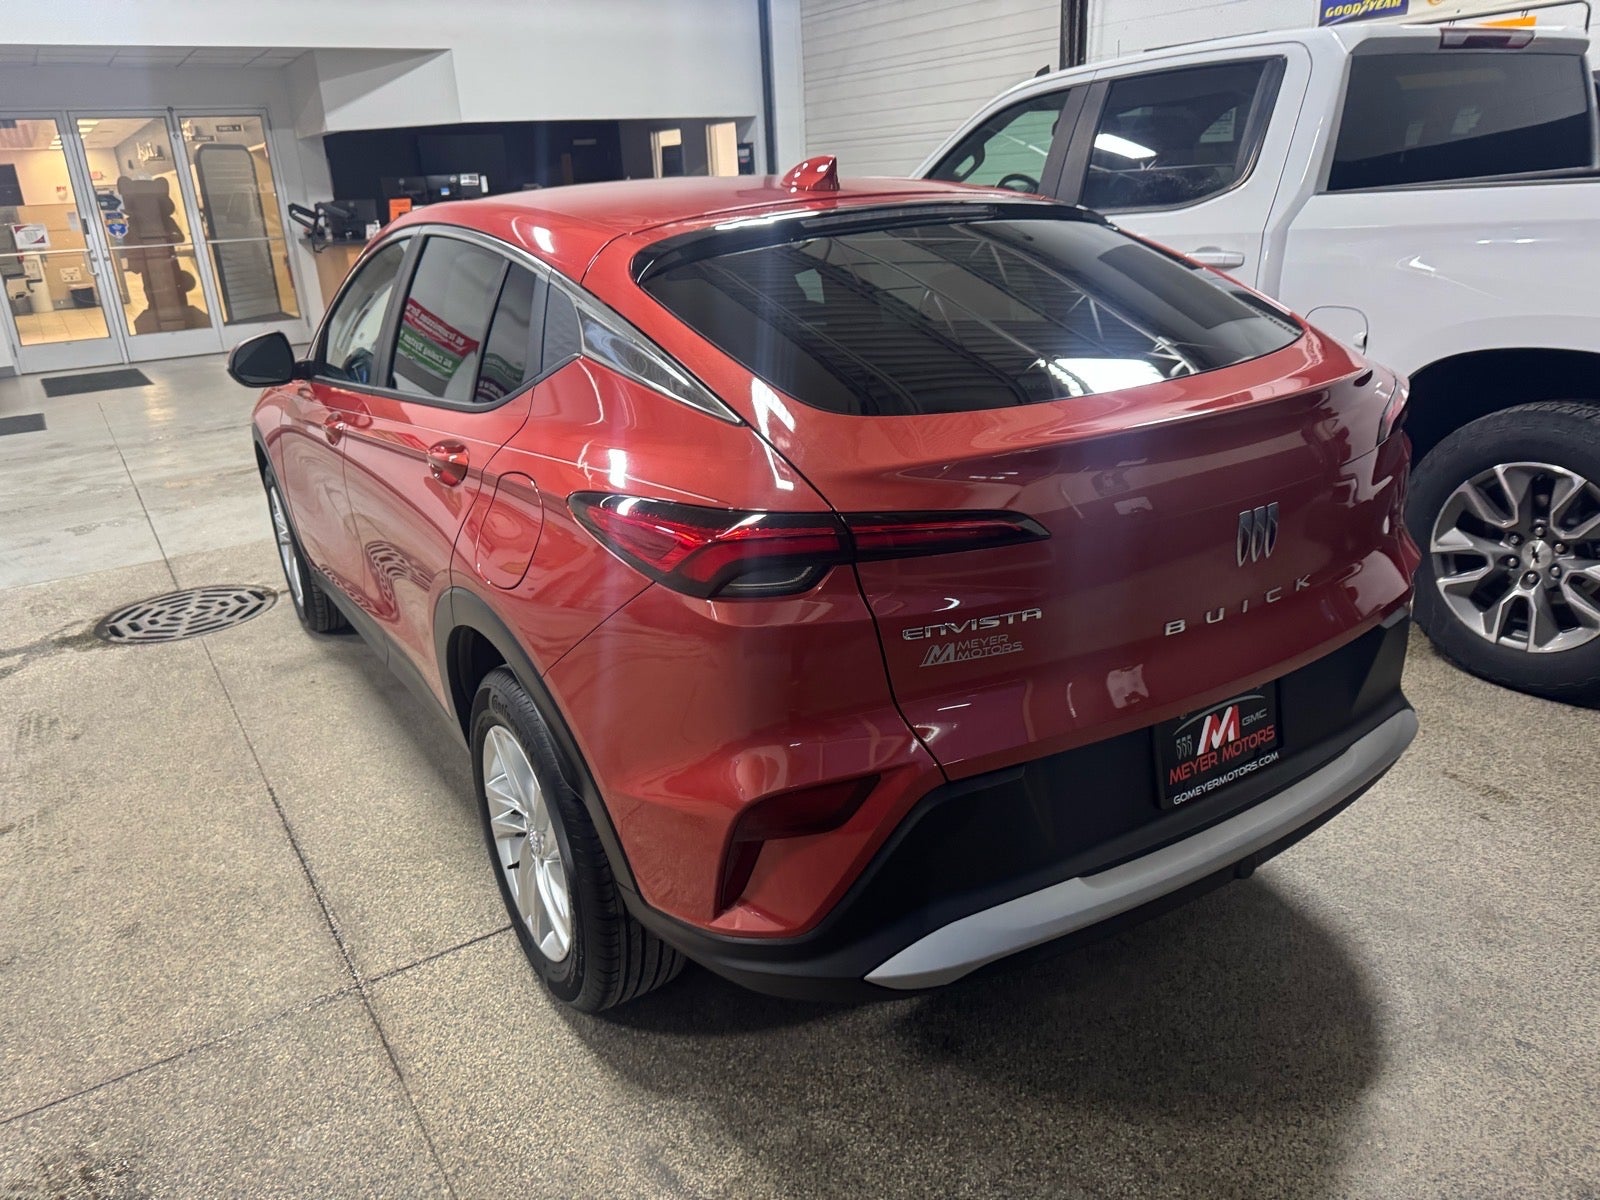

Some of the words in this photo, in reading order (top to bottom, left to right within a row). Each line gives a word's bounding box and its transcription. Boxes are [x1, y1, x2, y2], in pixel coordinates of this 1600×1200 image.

[1325, 0, 1402, 18] GOODYEAR
[1164, 574, 1311, 637] BUICK
[902, 607, 1043, 641] ENVISTA
[957, 633, 1009, 651] MEYER
[957, 641, 1023, 661] MOTORS
[1197, 704, 1240, 756] M
[1241, 708, 1268, 726] GMC
[1168, 752, 1219, 785] MEYER
[1222, 724, 1276, 763] MOTORS
[1173, 751, 1280, 806] GOMEYERMOTORS.COM
